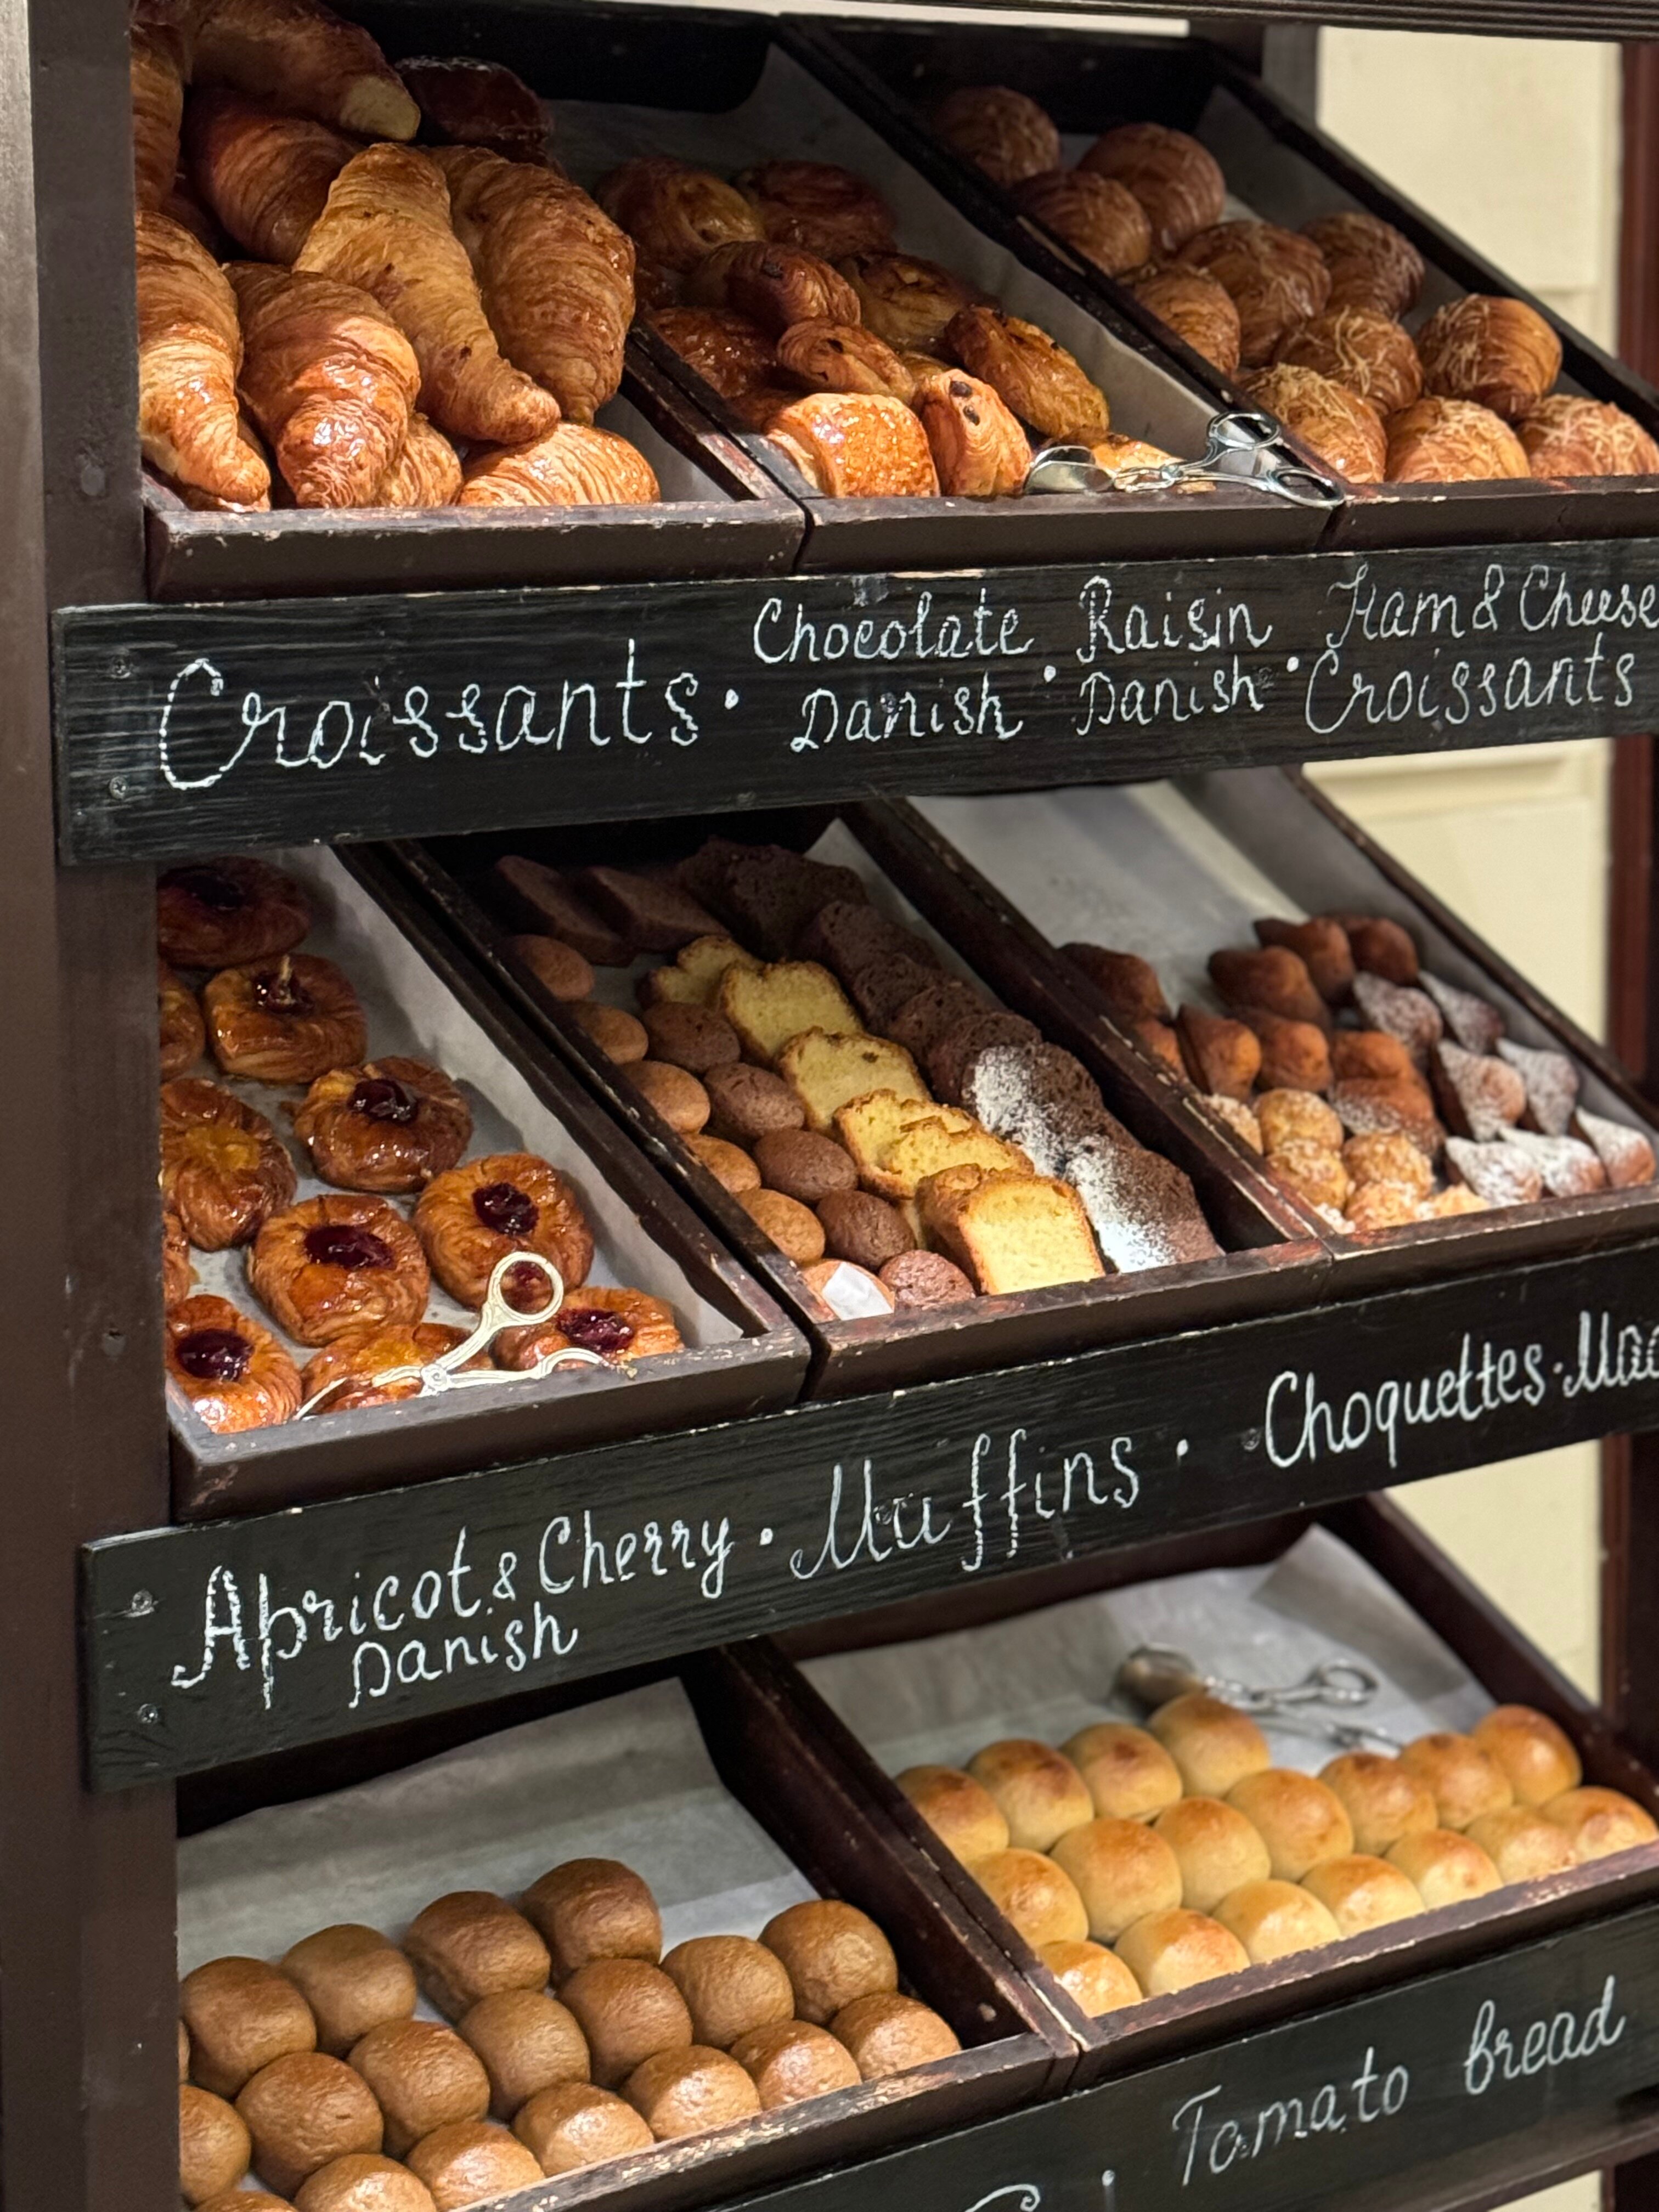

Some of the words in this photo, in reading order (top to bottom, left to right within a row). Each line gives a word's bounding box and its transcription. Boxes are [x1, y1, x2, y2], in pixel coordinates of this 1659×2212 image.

[753, 587, 1034, 664] Chocolate
[1076, 575, 1273, 664] Raisin
[1325, 561, 1465, 648] Ham
[1472, 564, 1505, 631] &
[159, 638, 700, 790] Croissants
[790, 669, 1024, 753] Danish
[1076, 654, 1265, 736] Danish
[1305, 632, 1636, 734] Croissants
[1265, 1332, 1545, 1469] Choquettes
[790, 1428, 1139, 1580] Muffins
[171, 1526, 483, 1711] Apricot
[497, 1551, 517, 1602] &
[538, 1510, 733, 1599] Cherry
[348, 1602, 579, 1709] Danish
[1172, 2046, 1409, 2187] Tomato
[1464, 1975, 1626, 2096] bread
